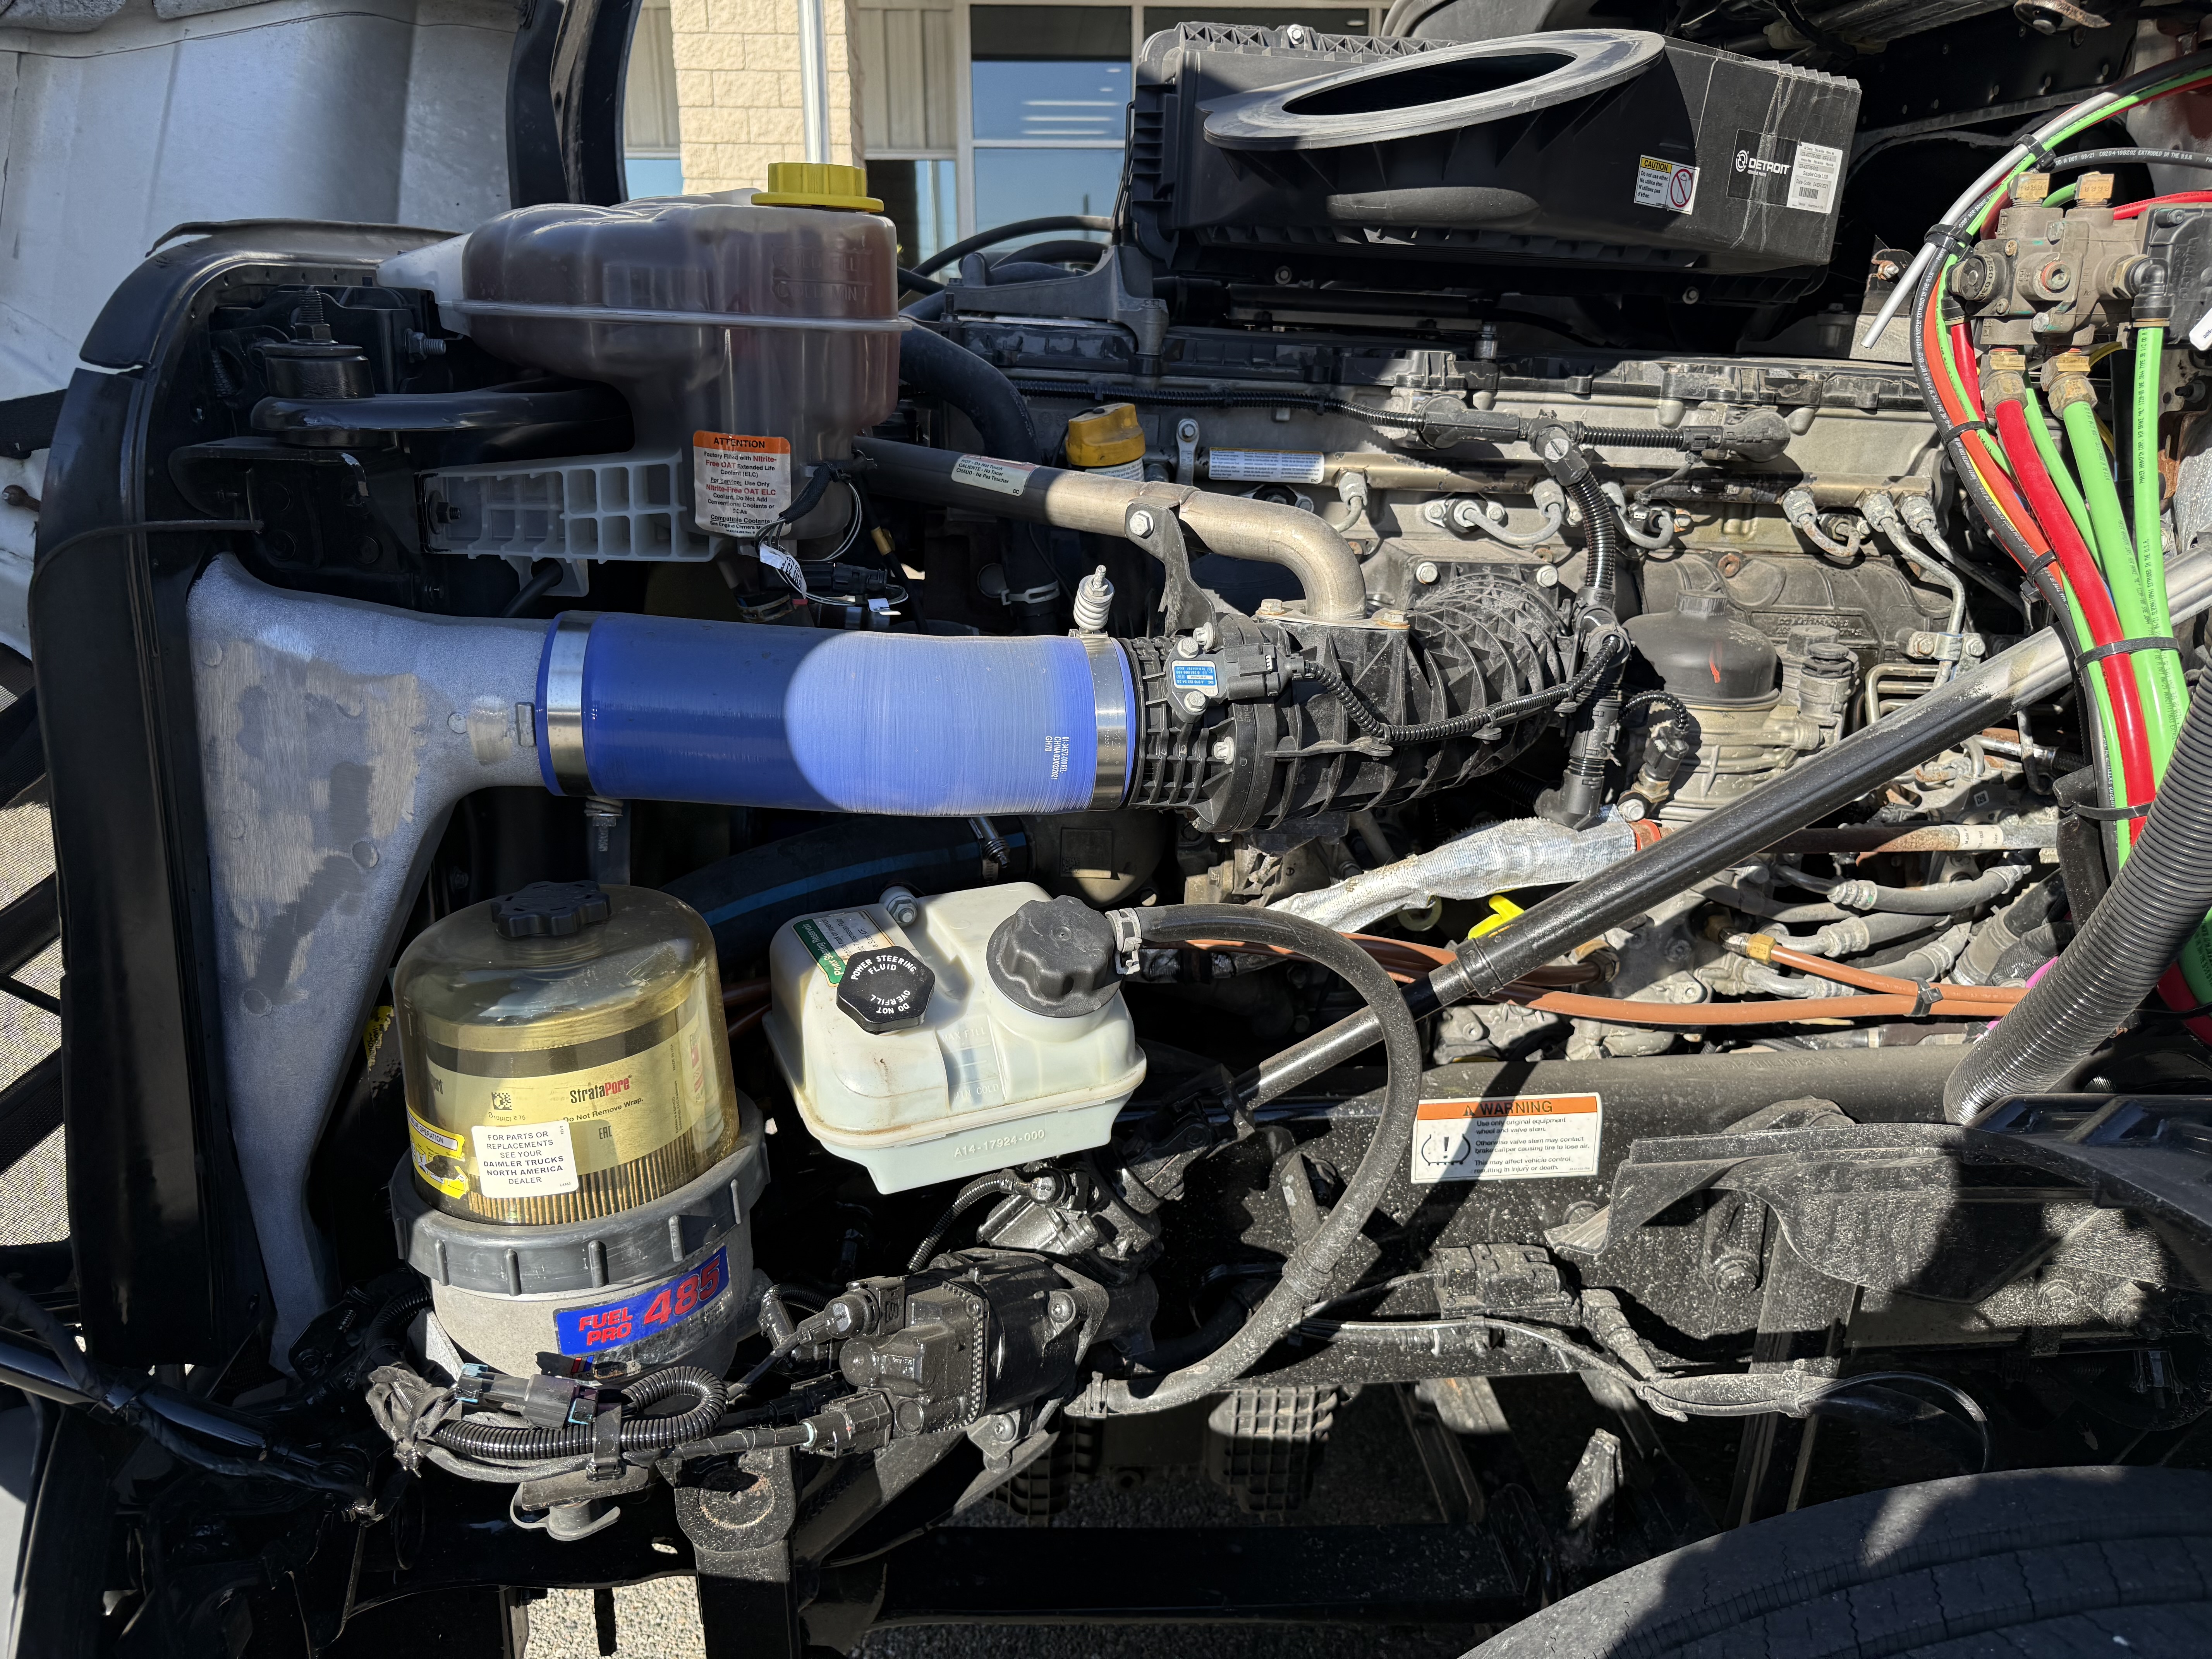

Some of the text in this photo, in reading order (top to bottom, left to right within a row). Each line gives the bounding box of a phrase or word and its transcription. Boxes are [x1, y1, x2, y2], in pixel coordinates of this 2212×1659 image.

[1644, 160, 1668, 171] CAUTION
[1748, 158, 1791, 175] DETROIT
[713, 437, 765, 448] ATTENTION
[704, 451, 722, 459] Factory
[958, 463, 980, 471] CALIENTE
[706, 484, 742, 494] Nitrite-Free
[708, 499, 741, 507] Conventional
[711, 514, 742, 523] Compatible
[1044, 736, 1053, 752] GH70
[1061, 736, 1070, 764] 01-34572-000
[1051, 736, 1061, 780] CHINA 03/02/2021
[803, 923, 833, 961] Steering Reservoir
[851, 955, 917, 980] POWER STEERING
[867, 963, 896, 975] FLUID
[870, 990, 911, 1006] OVERFILL
[898, 1003, 910, 1012] DO
[941, 1027, 985, 1042] MAX FILL
[953, 1084, 999, 1100] MIN COLD
[592, 1104, 622, 1117] Remove
[623, 1097, 644, 1108] Wrap.
[1479, 1100, 1552, 1115] WARNING
[1491, 1119, 1504, 1128] only
[1506, 1118, 1530, 1126] original
[1532, 1117, 1566, 1125] equipment
[419, 1124, 444, 1144] OPERATION
[486, 1139, 554, 1149] REPLACEMENTS
[954, 1129, 1045, 1158] A14-17924-000
[517, 1150, 542, 1158] YOUR
[1494, 1146, 1516, 1154] caliper
[524, 1156, 564, 1166] TRUCKS
[520, 1165, 563, 1175] AMERICA
[1474, 1166, 1503, 1174] resulting
[1511, 1164, 1529, 1173] injury
[508, 1176, 542, 1185] DEALER
[643, 1254, 721, 1325] 485
[578, 1306, 633, 1332] FUEL
[586, 1322, 632, 1346] PRO
